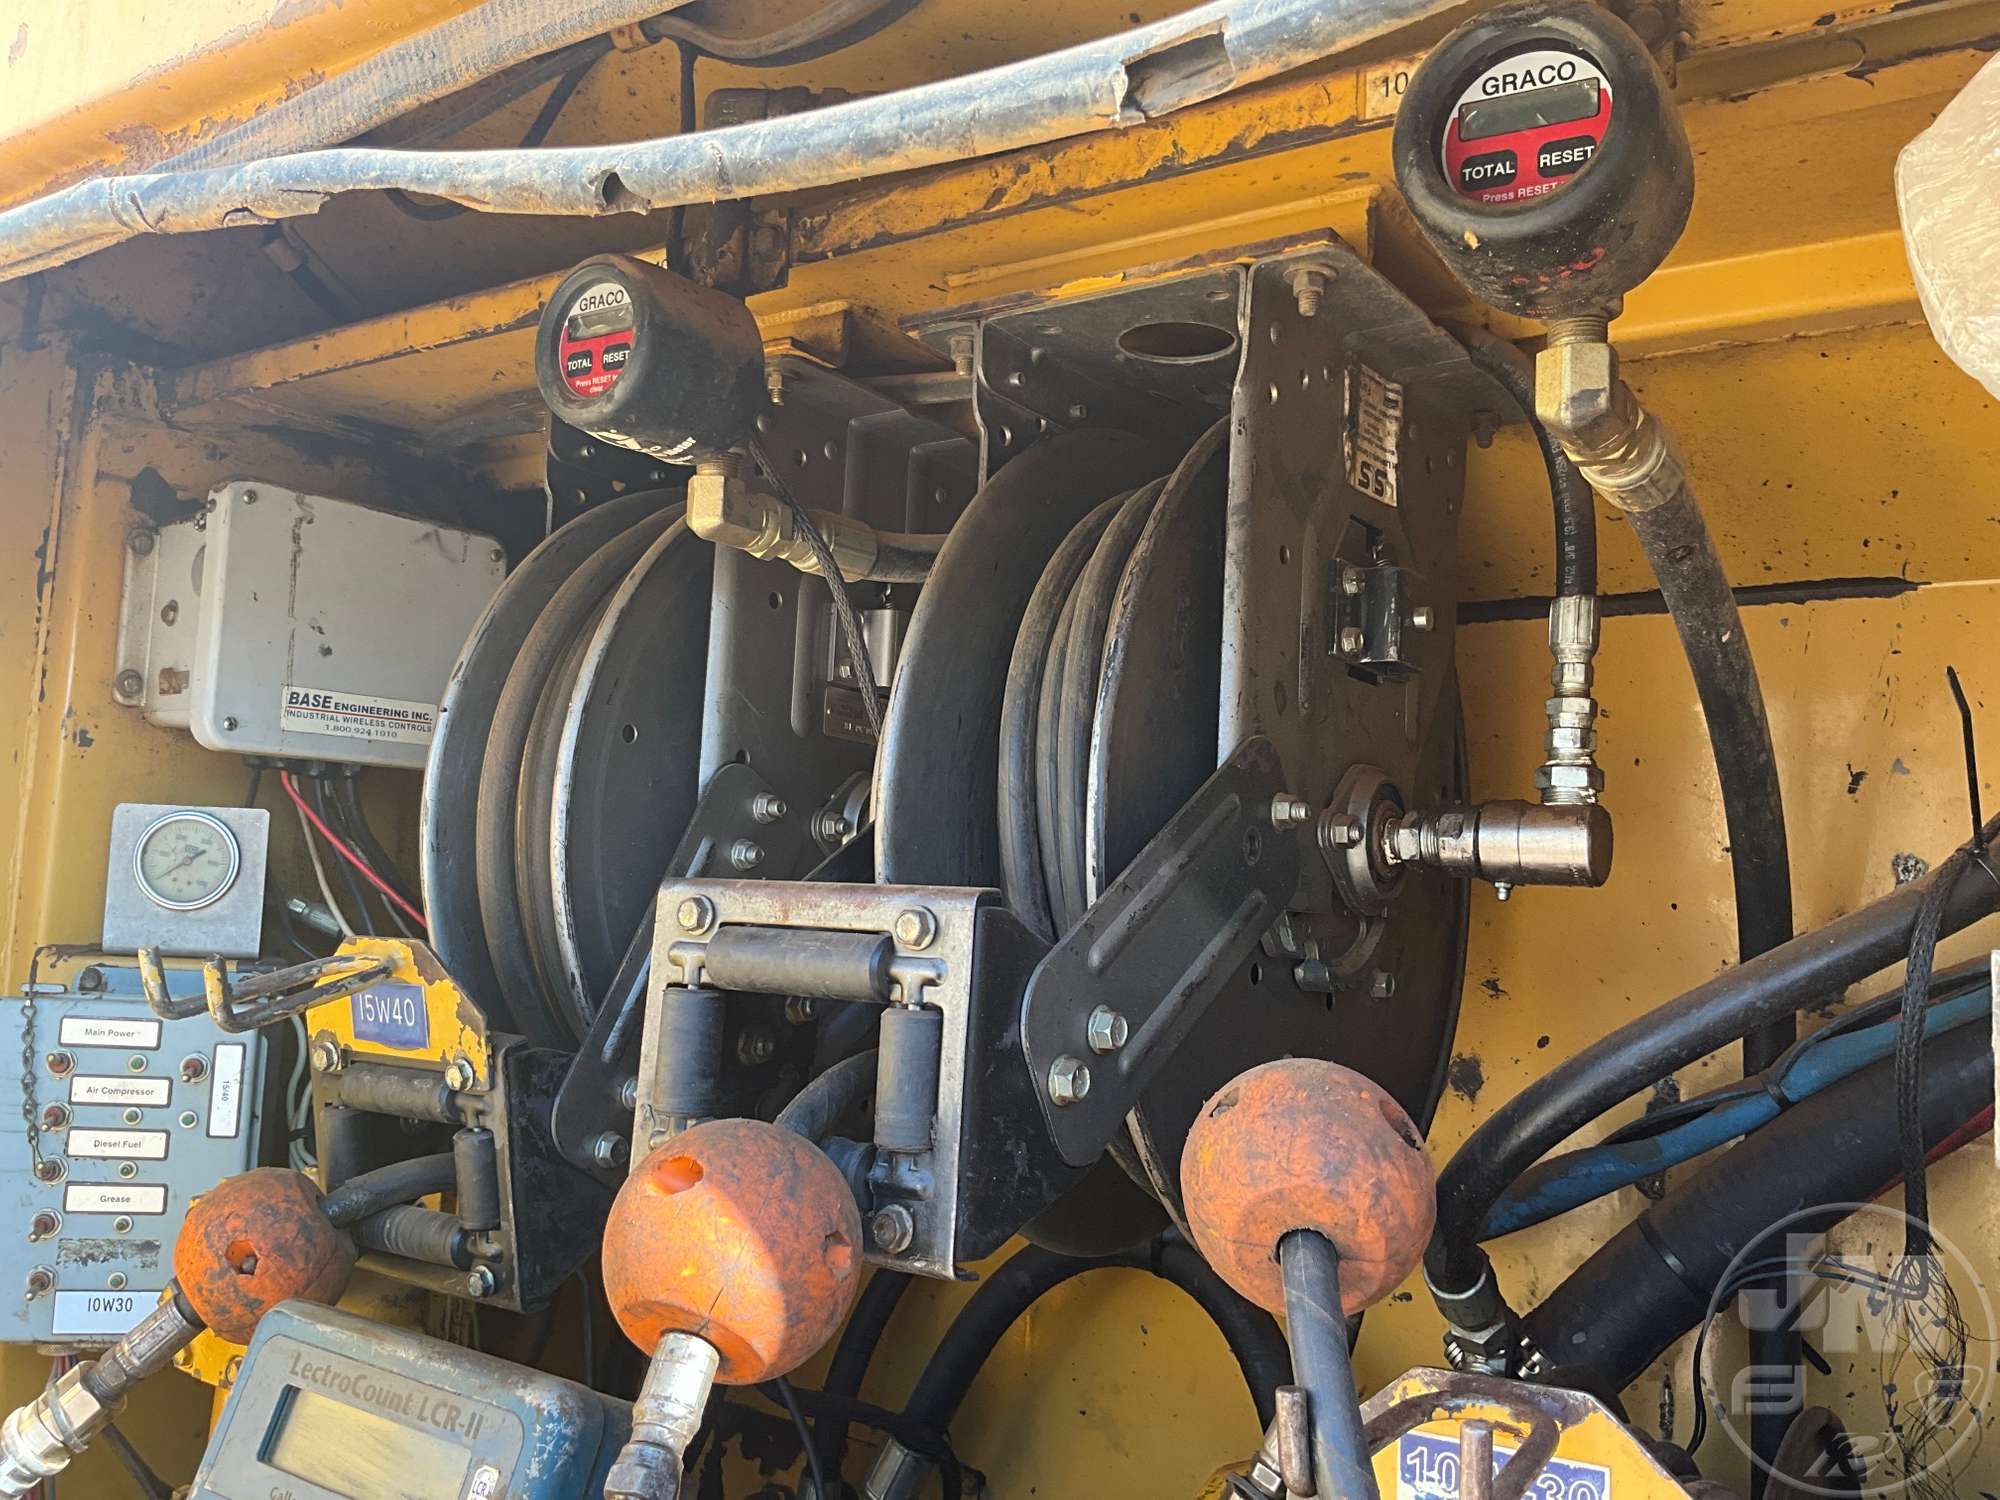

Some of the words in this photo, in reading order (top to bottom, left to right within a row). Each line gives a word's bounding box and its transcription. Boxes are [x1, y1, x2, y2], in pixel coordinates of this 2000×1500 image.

[1482, 60, 1576, 96] GRACO
[1462, 160, 1516, 181] TOTAL
[1539, 145, 1595, 168] RESET
[1518, 182, 1558, 197] RESET
[579, 289, 624, 312] GRACO
[567, 358, 593, 371] TOTAL
[602, 350, 631, 364] RESET
[575, 380, 592, 388] Press
[592, 374, 612, 384] RESET
[288, 691, 333, 709] BASE
[334, 702, 409, 719] ENGINEERING
[411, 712, 433, 721] INC.
[286, 709, 341, 723] INDUSTRIAL
[342, 716, 386, 727] WIRELESS
[388, 721, 432, 733] CONTROLS
[359, 993, 415, 1027] 15W40
[84, 1028, 106, 1037] Main
[108, 1029, 135, 1038] Power
[86, 1086, 99, 1094] Air
[101, 1086, 155, 1097] Compressor
[221, 1080, 230, 1102] 15/40
[93, 1139, 121, 1149] Diesel
[122, 1140, 142, 1149] Fuel
[99, 1195, 131, 1204] Grease
[87, 1297, 134, 1313] 10W30
[288, 1351, 415, 1416] LectroCount
[417, 1396, 484, 1441] LCR-II
